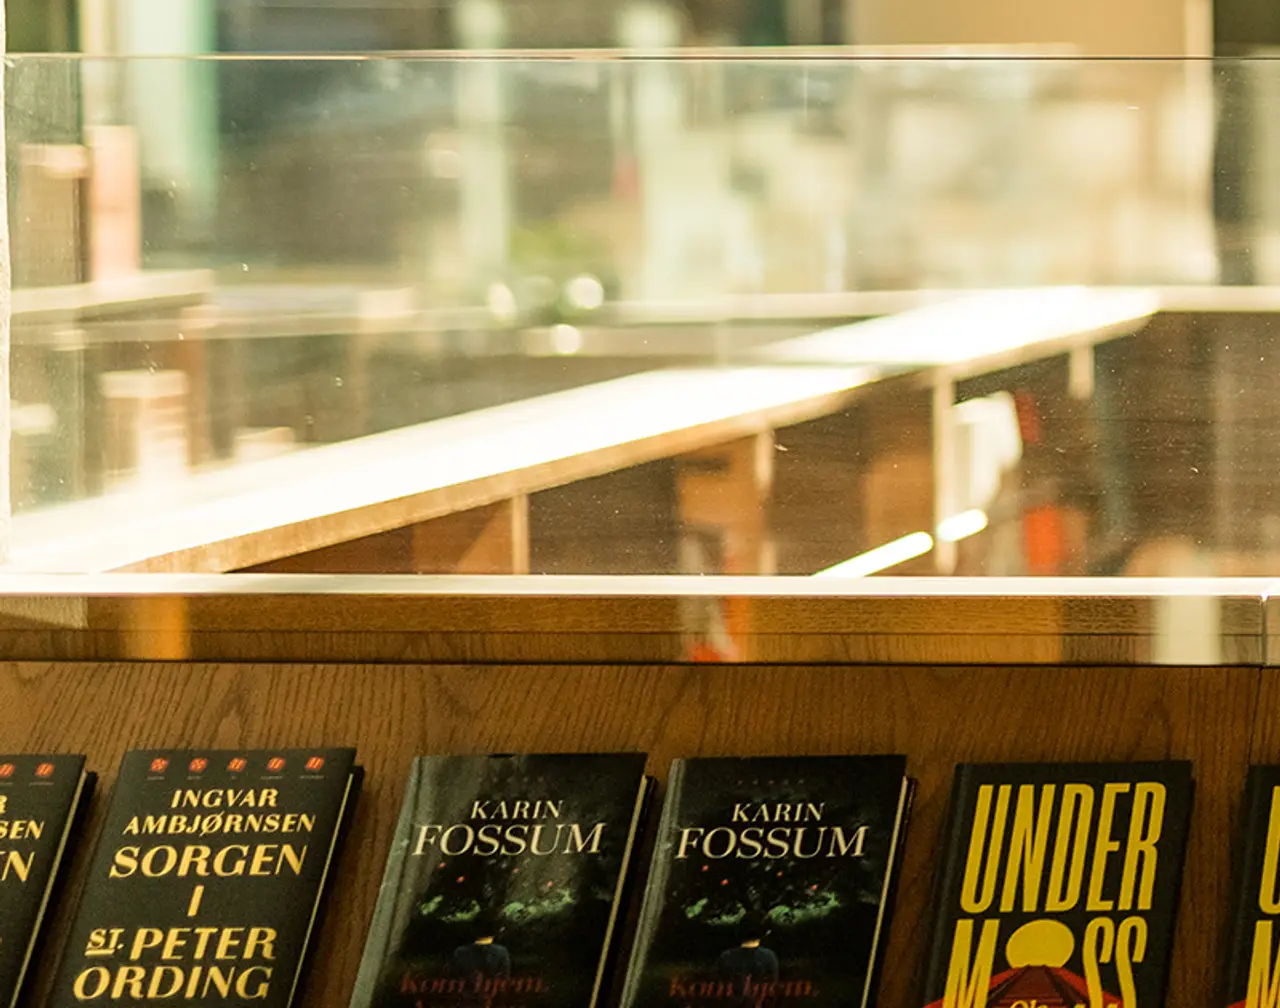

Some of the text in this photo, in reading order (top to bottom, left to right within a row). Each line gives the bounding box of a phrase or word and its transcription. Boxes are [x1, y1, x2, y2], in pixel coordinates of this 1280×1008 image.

[171, 788, 279, 808] INGVAR
[470, 799, 564, 820] KARIN
[731, 802, 826, 823] KARIN
[123, 813, 316, 838] AMBJØRNSEN
[411, 822, 607, 857] FOSSUM
[674, 825, 870, 859] FOSSUM
[109, 844, 308, 879] SORGEN
[960, 781, 1167, 915] UNDER
[187, 884, 205, 918] I
[129, 927, 279, 961] PETER
[73, 965, 273, 1001] ORDING
